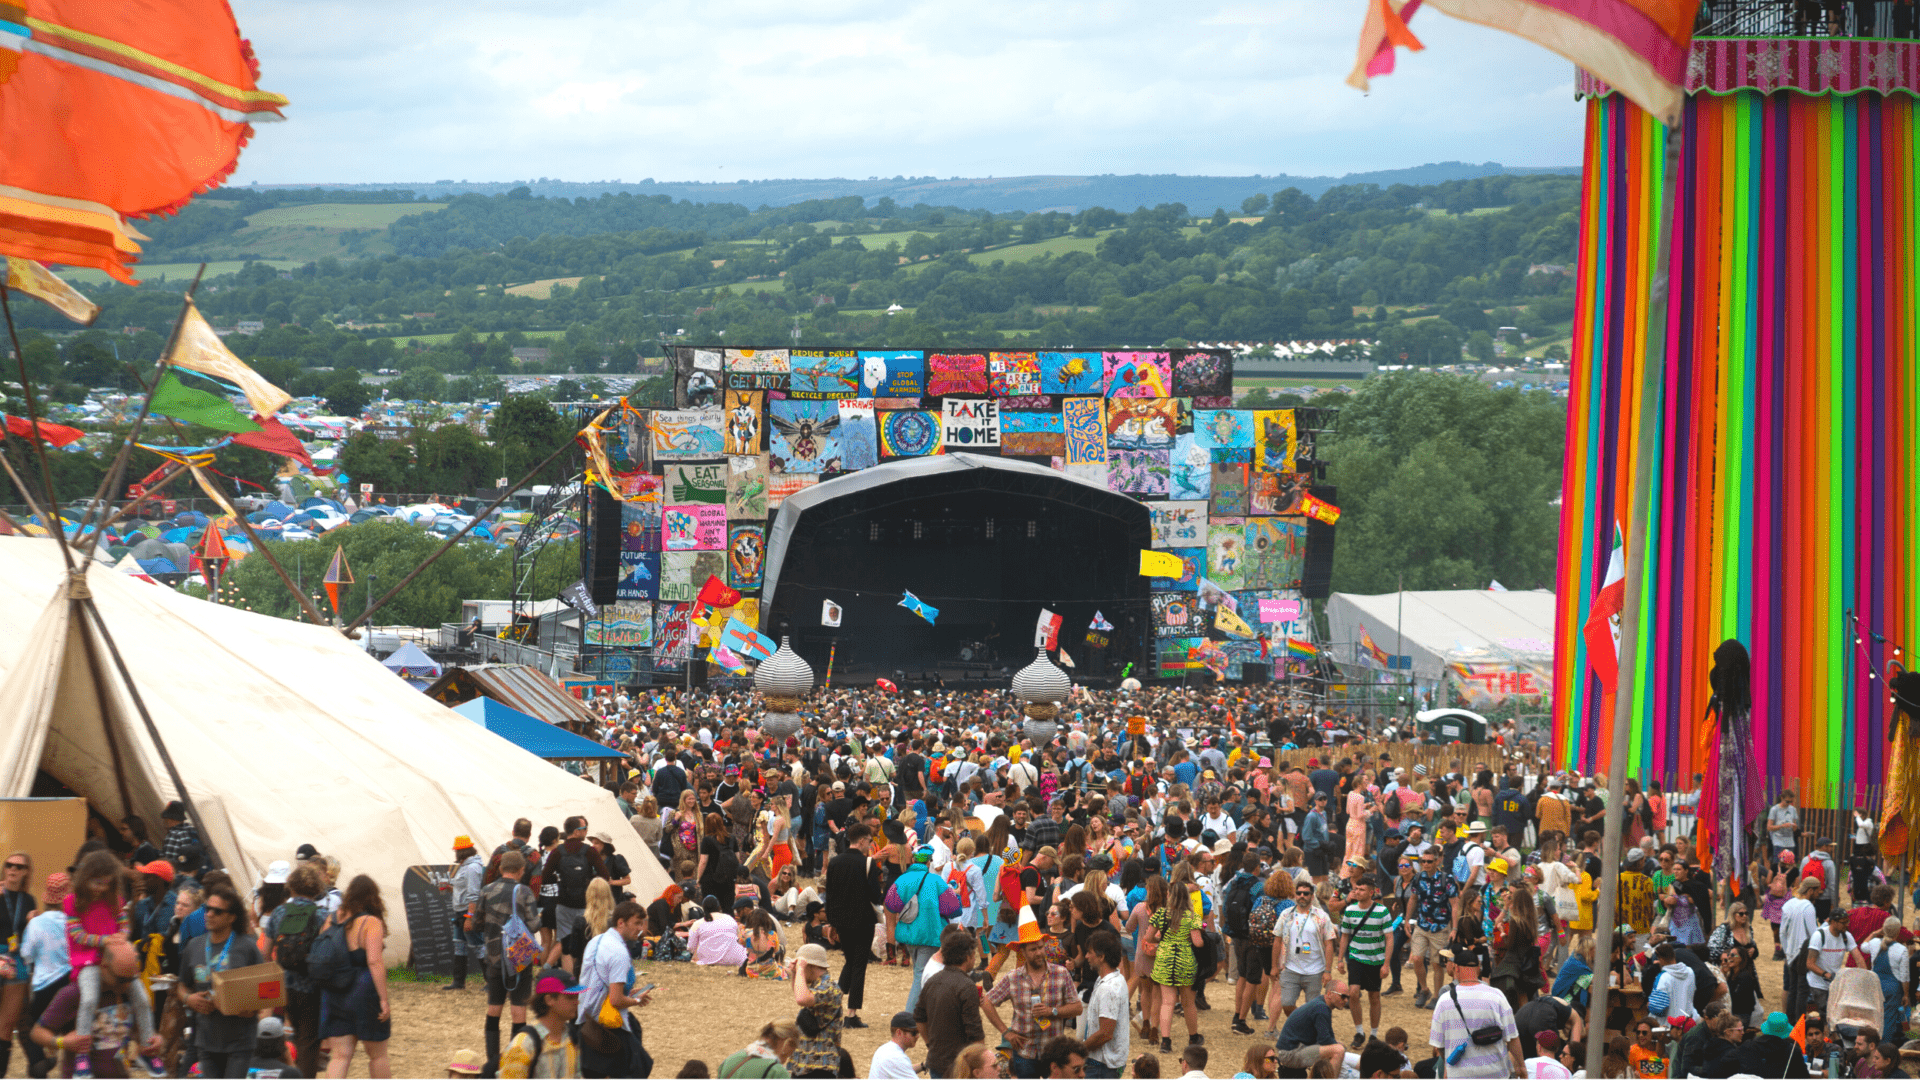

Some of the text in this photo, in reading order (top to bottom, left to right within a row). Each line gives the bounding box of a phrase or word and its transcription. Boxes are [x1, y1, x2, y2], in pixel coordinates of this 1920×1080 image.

[991, 361, 1004, 371] WE
[729, 374, 787, 389] GET DIRTY
[1006, 373, 1029, 384] ARE
[1020, 383, 1038, 394] ONE
[791, 391, 858, 400] RECYCLE RECLAIM
[839, 399, 875, 410] STRAWS
[948, 401, 997, 418] TAKE
[660, 411, 721, 424] Sea things clearly
[982, 418, 992, 426] IT
[947, 426, 998, 444] HOME
[695, 466, 721, 480] EAT
[692, 478, 727, 489] SEASONAL
[1252, 492, 1277, 511] LOVE
[703, 536, 722, 544] COOL
[628, 589, 649, 598] HANDS
[661, 583, 690, 600] WIND
[1152, 594, 1182, 613] PLASTIC
[656, 610, 690, 622] DANCE
[596, 631, 642, 642] REWILD
[1476, 671, 1541, 694] THE
